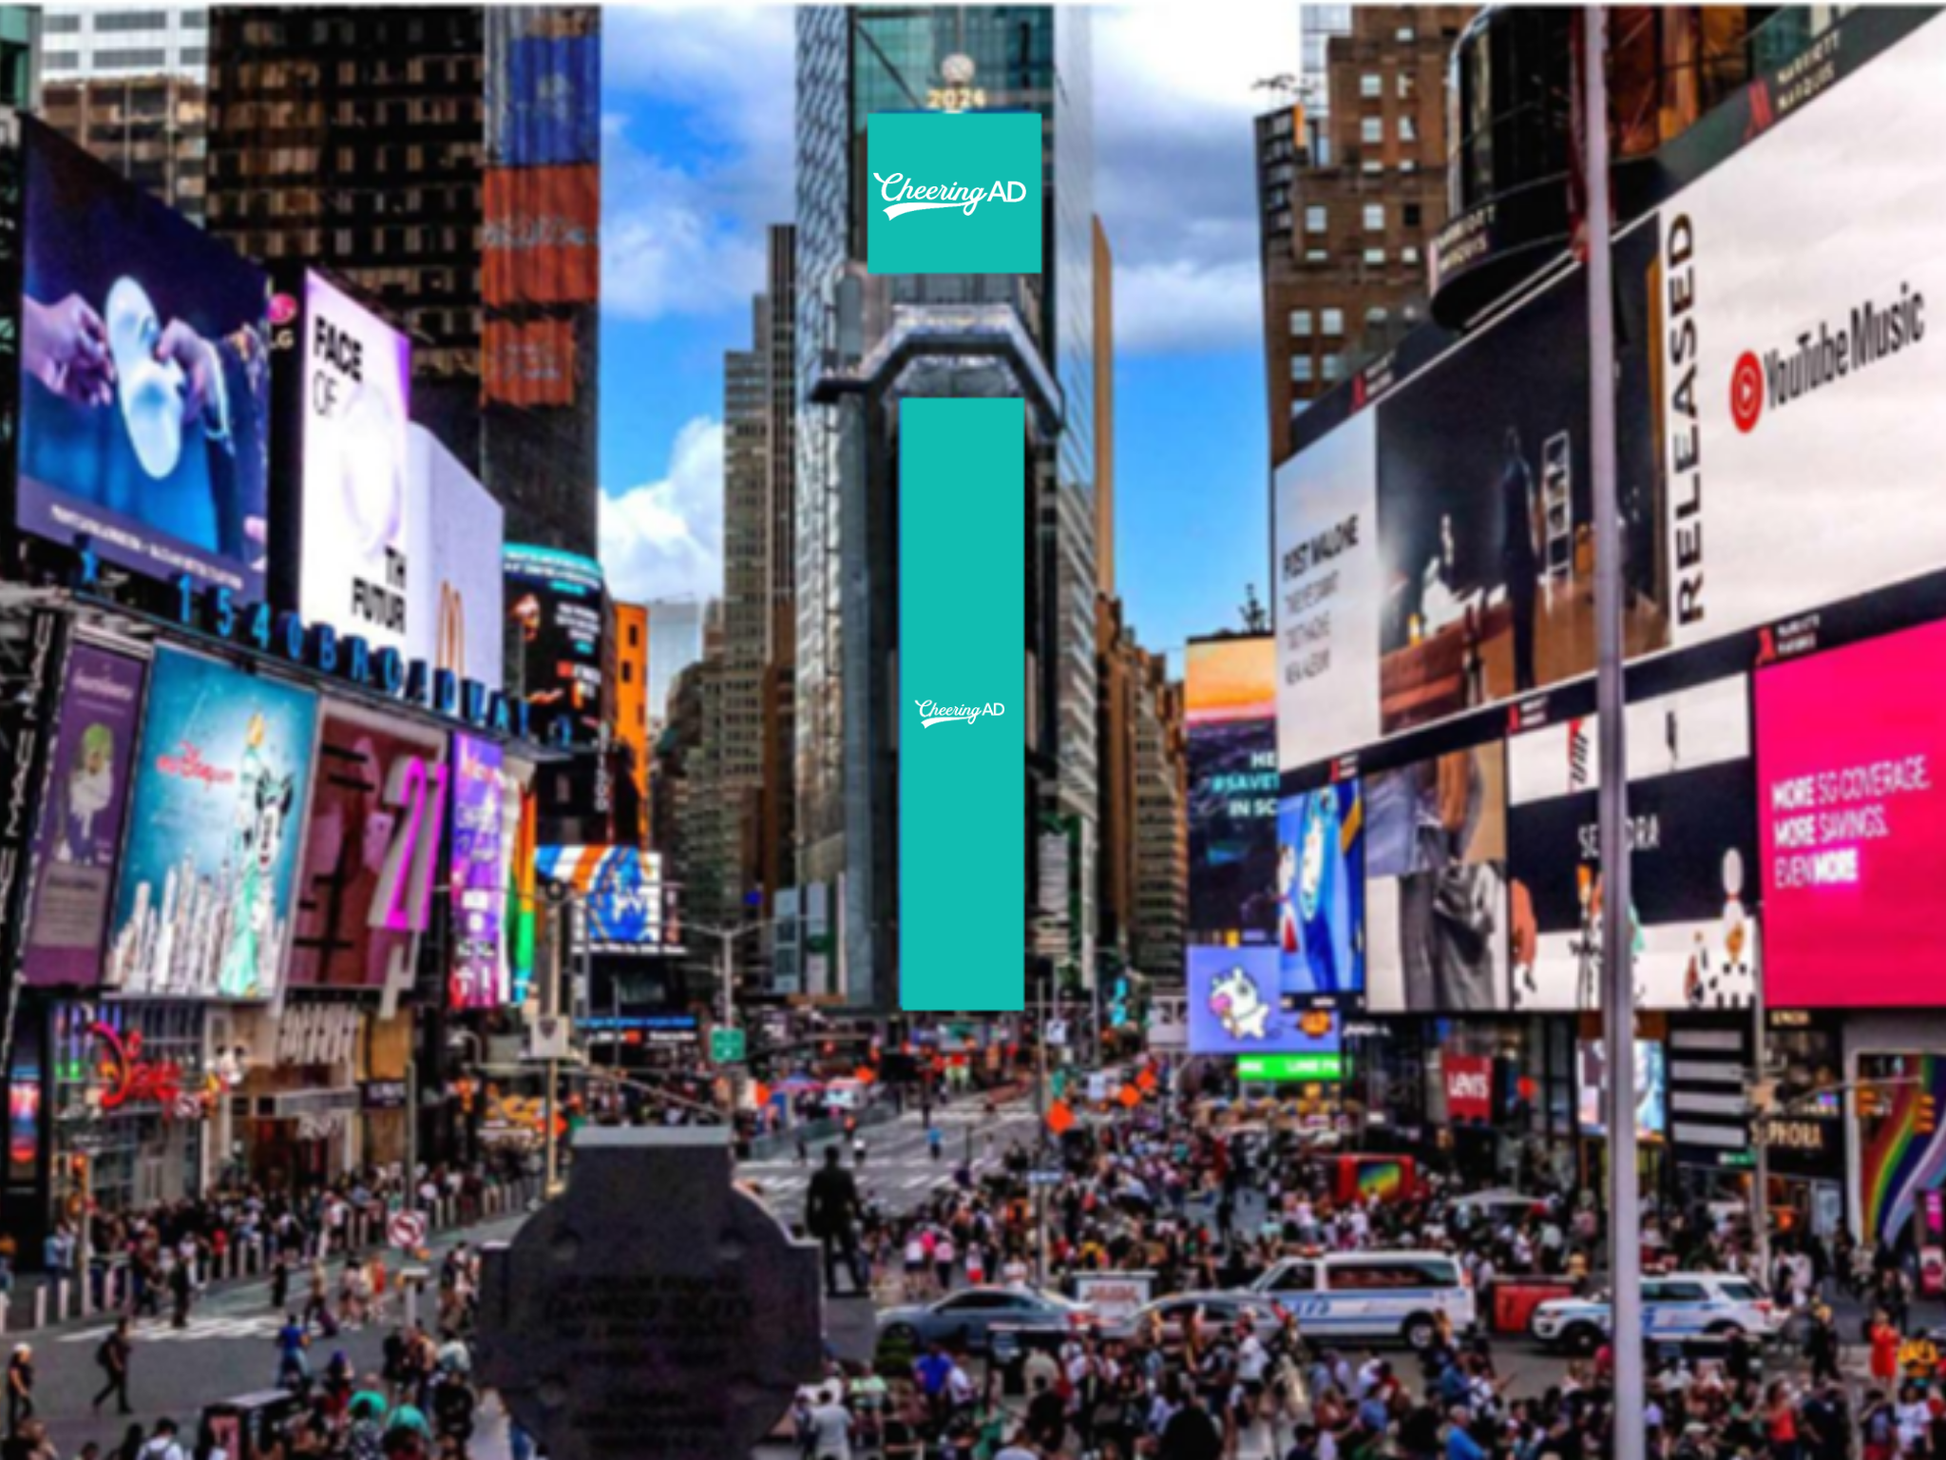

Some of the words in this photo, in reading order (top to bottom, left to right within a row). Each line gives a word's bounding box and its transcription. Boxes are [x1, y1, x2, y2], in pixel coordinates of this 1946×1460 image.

[315, 315, 363, 384] FACE
[1764, 320, 1848, 409] YouTube
[1850, 281, 1925, 371] Music
[313, 370, 338, 416] OF
[1667, 212, 1705, 626] RELEASED
[1771, 775, 1815, 813] MORE
[1817, 771, 1839, 804] 5G
[1773, 813, 1816, 849] MORE
[1774, 855, 1815, 890] EVEN
[1814, 847, 1859, 885] MORE
[1750, 1120, 1823, 1148] SPHORA
